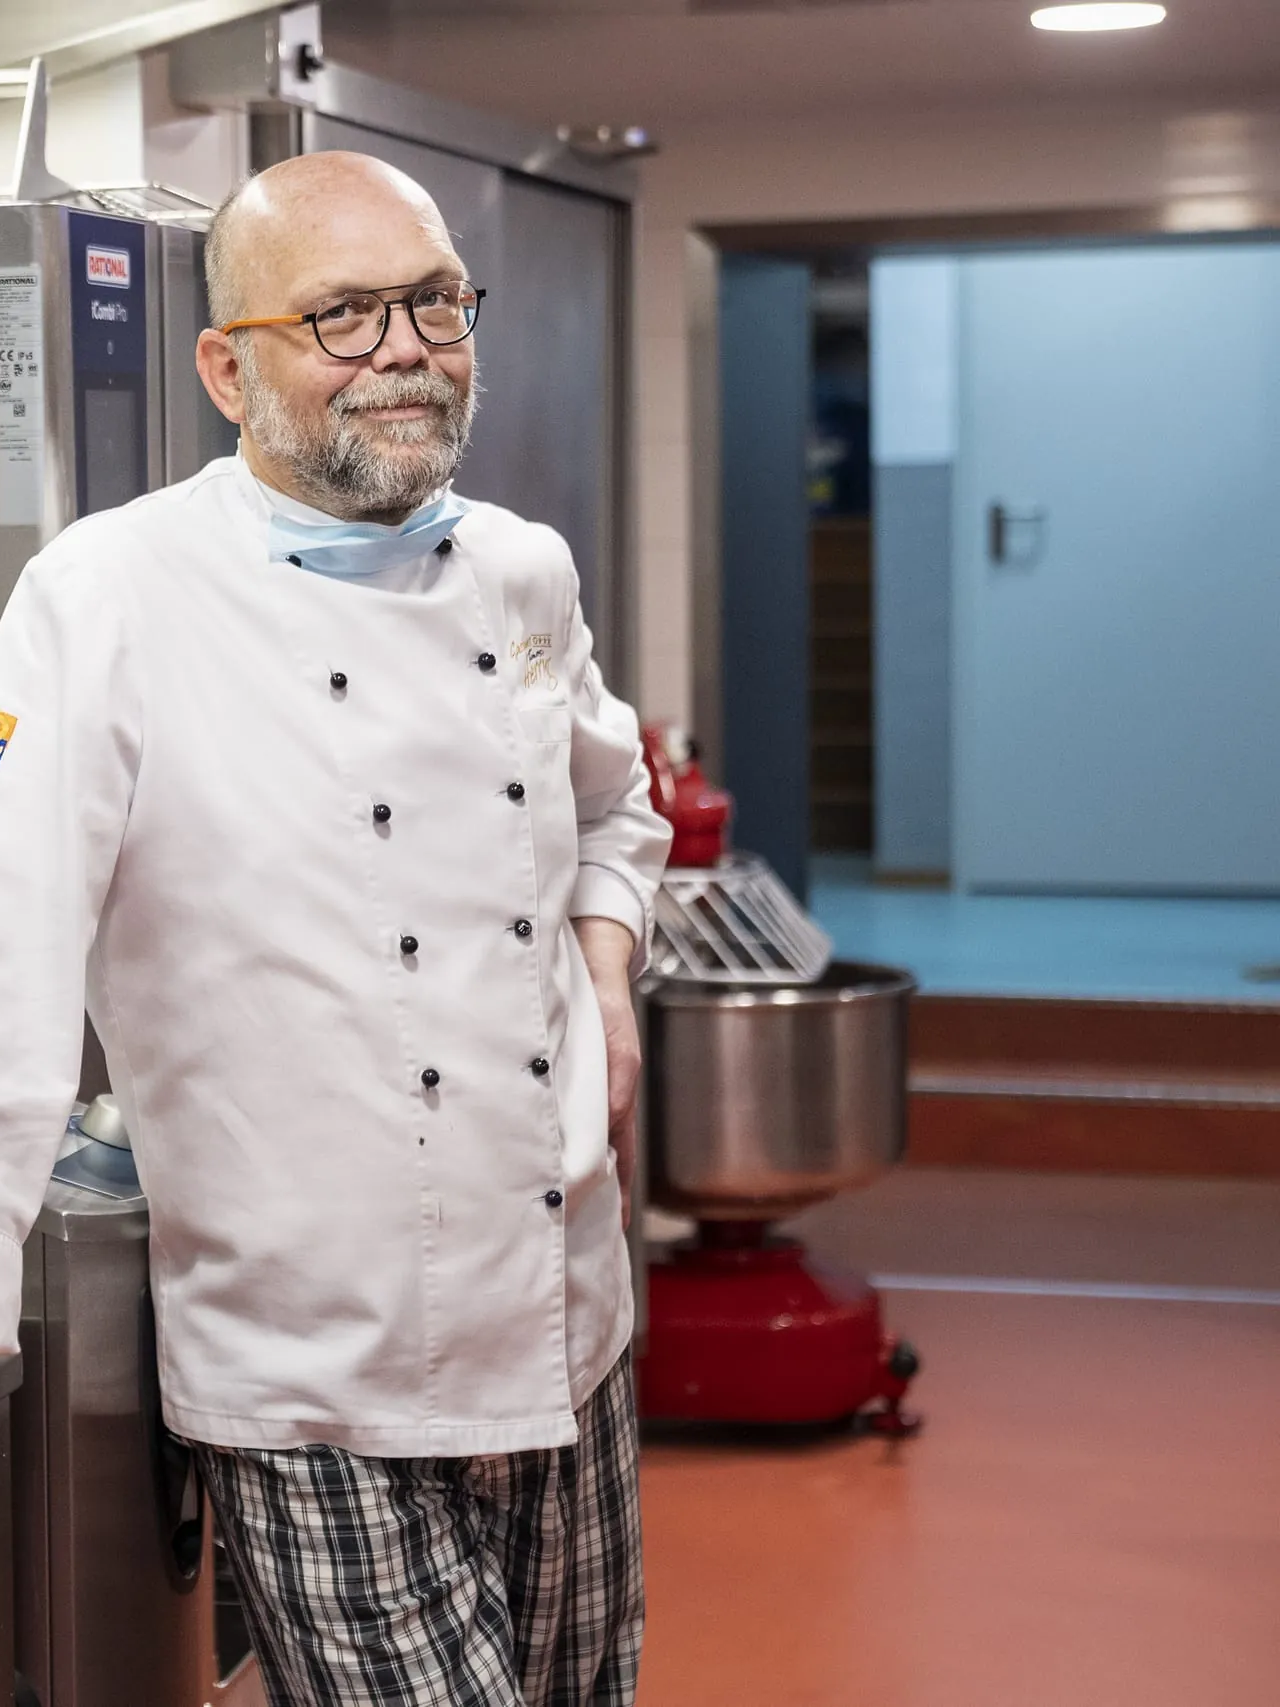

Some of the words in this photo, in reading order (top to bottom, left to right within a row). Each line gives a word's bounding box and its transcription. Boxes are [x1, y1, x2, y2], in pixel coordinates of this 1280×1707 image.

[89, 256, 127, 278] RATIONAL
[0, 278, 35, 286] RATIONAL
[91, 300, 114, 321] iCombi
